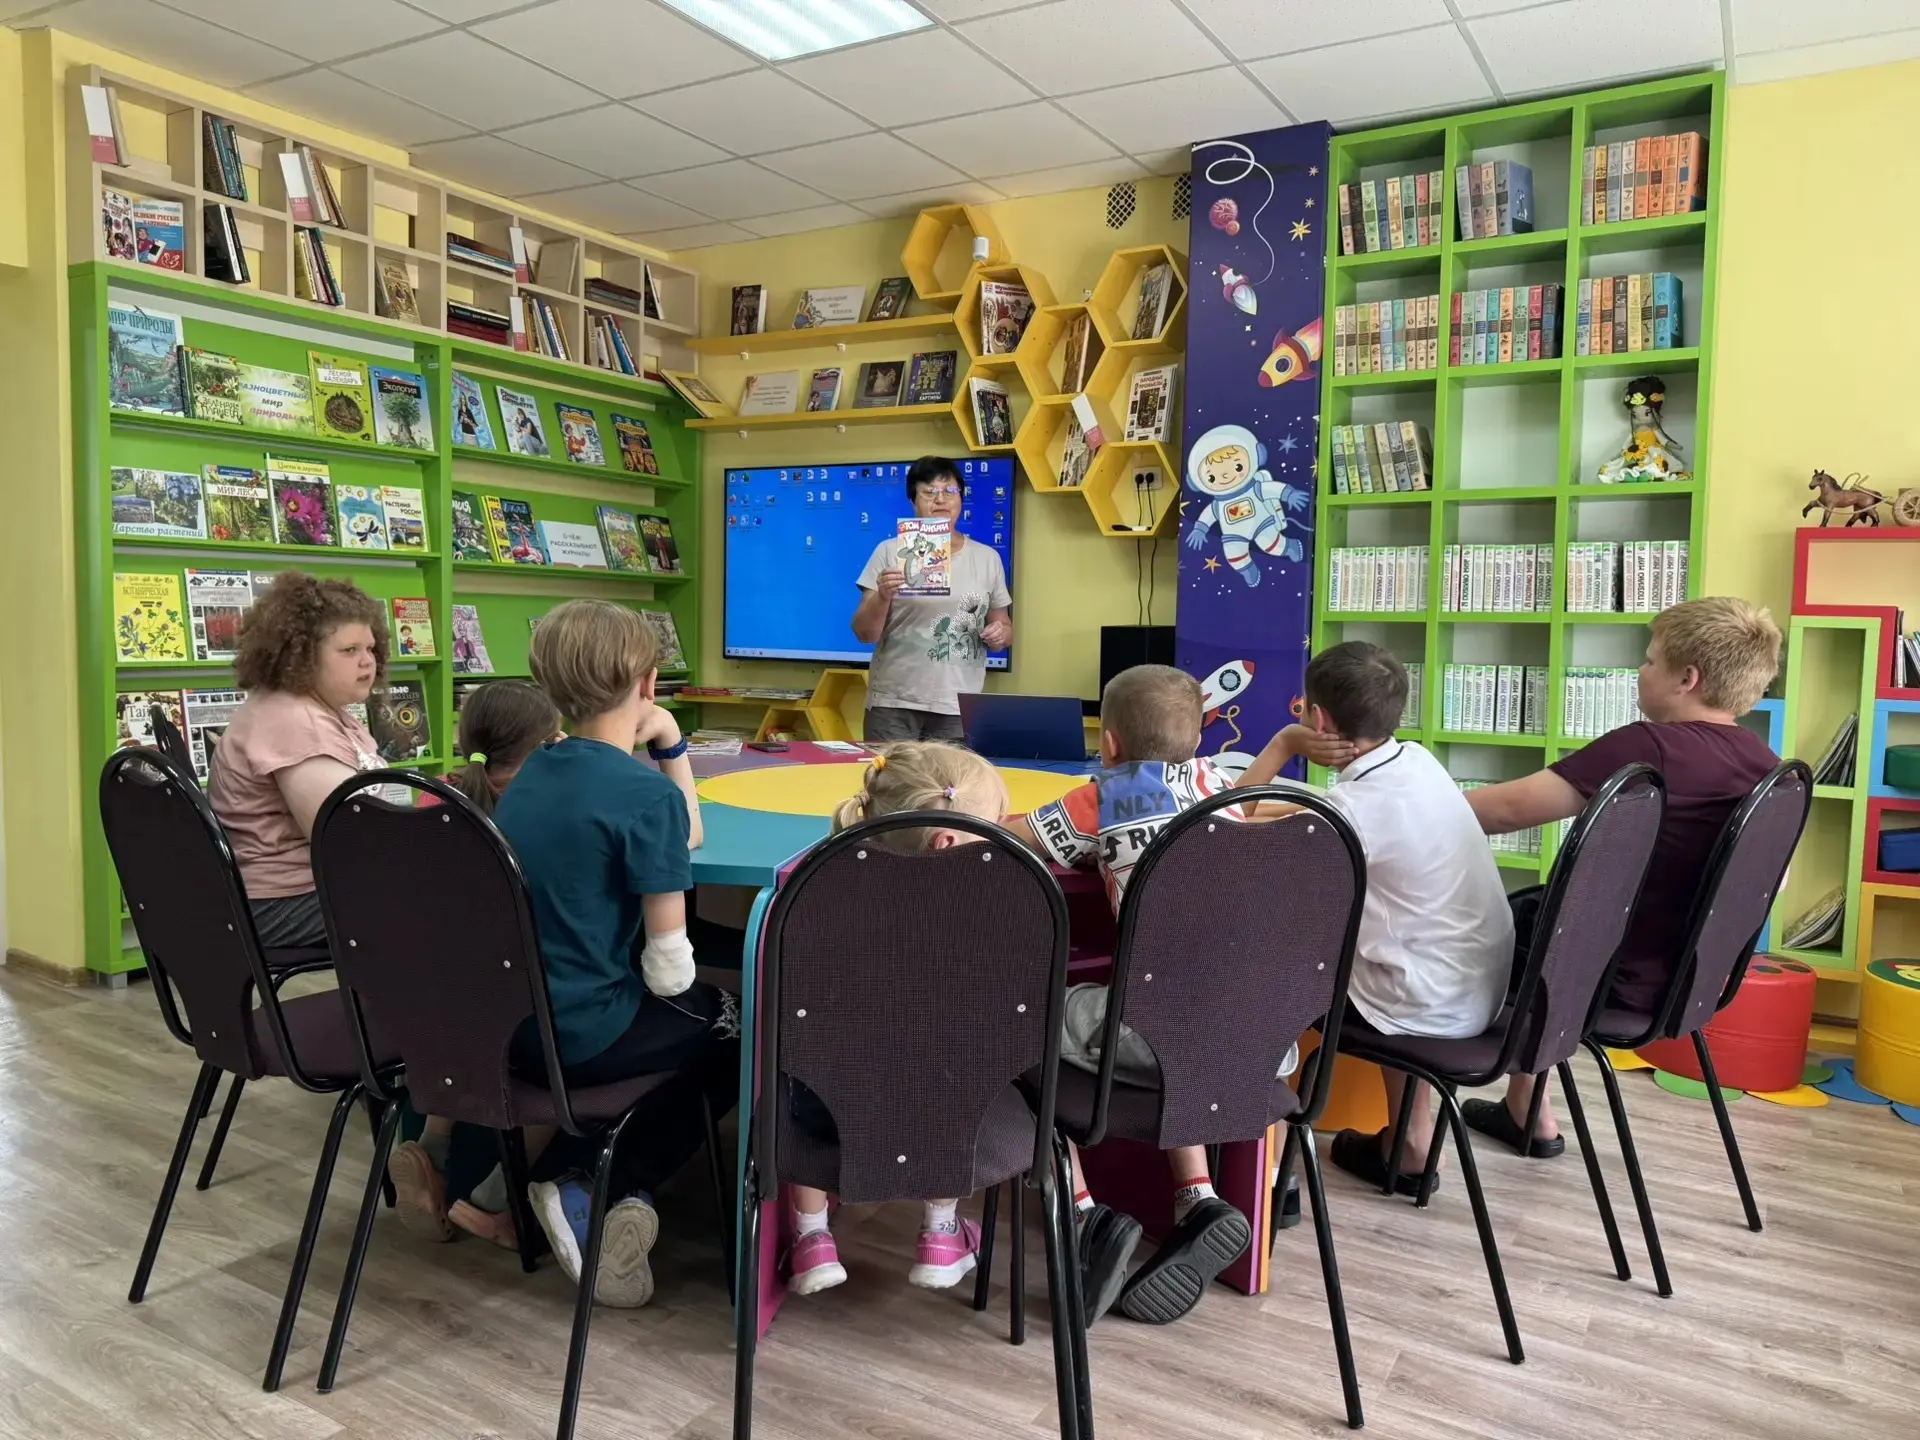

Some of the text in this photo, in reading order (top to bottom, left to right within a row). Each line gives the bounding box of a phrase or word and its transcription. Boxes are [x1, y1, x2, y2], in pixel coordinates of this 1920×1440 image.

[108, 310, 173, 335] МИР ПРИРОДЫ
[217, 486, 258, 497] МИР ЛЕСА
[112, 522, 204, 538] Царство растений
[904, 521, 950, 533] ТОМ ДЖЕРРИ
[1637, 556, 1645, 570] МИР
[1652, 555, 1661, 569] МИР
[1666, 555, 1674, 569] МИР
[1637, 572, 1645, 600] ПОЗНАЮ
[1652, 571, 1660, 601] ПОЗНАЮ
[1665, 571, 1673, 601] ПОЗНАЮ
[1678, 555, 1688, 601] ПОЗНАЮ МИР
[1511, 680, 1519, 693] МИР
[1484, 695, 1492, 720] ПОЗНАЮ
[1510, 695, 1518, 720] ПОЗНАЮ
